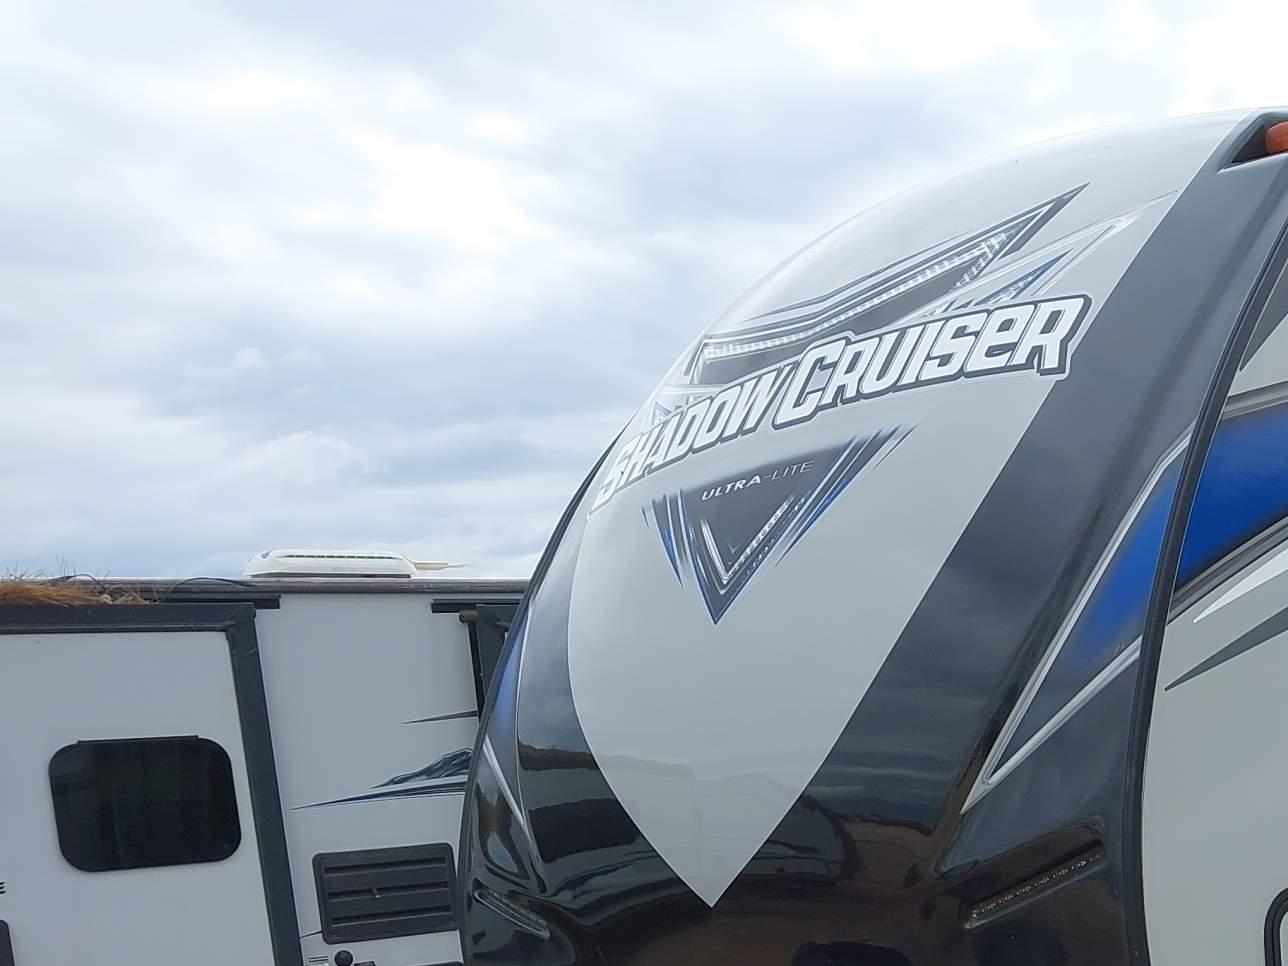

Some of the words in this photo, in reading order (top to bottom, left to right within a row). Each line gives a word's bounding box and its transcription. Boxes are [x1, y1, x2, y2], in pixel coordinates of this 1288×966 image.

[588, 364, 795, 513] SHADOW
[772, 296, 1091, 430] CRUISER
[701, 460, 815, 500] ULTRA-LITE
